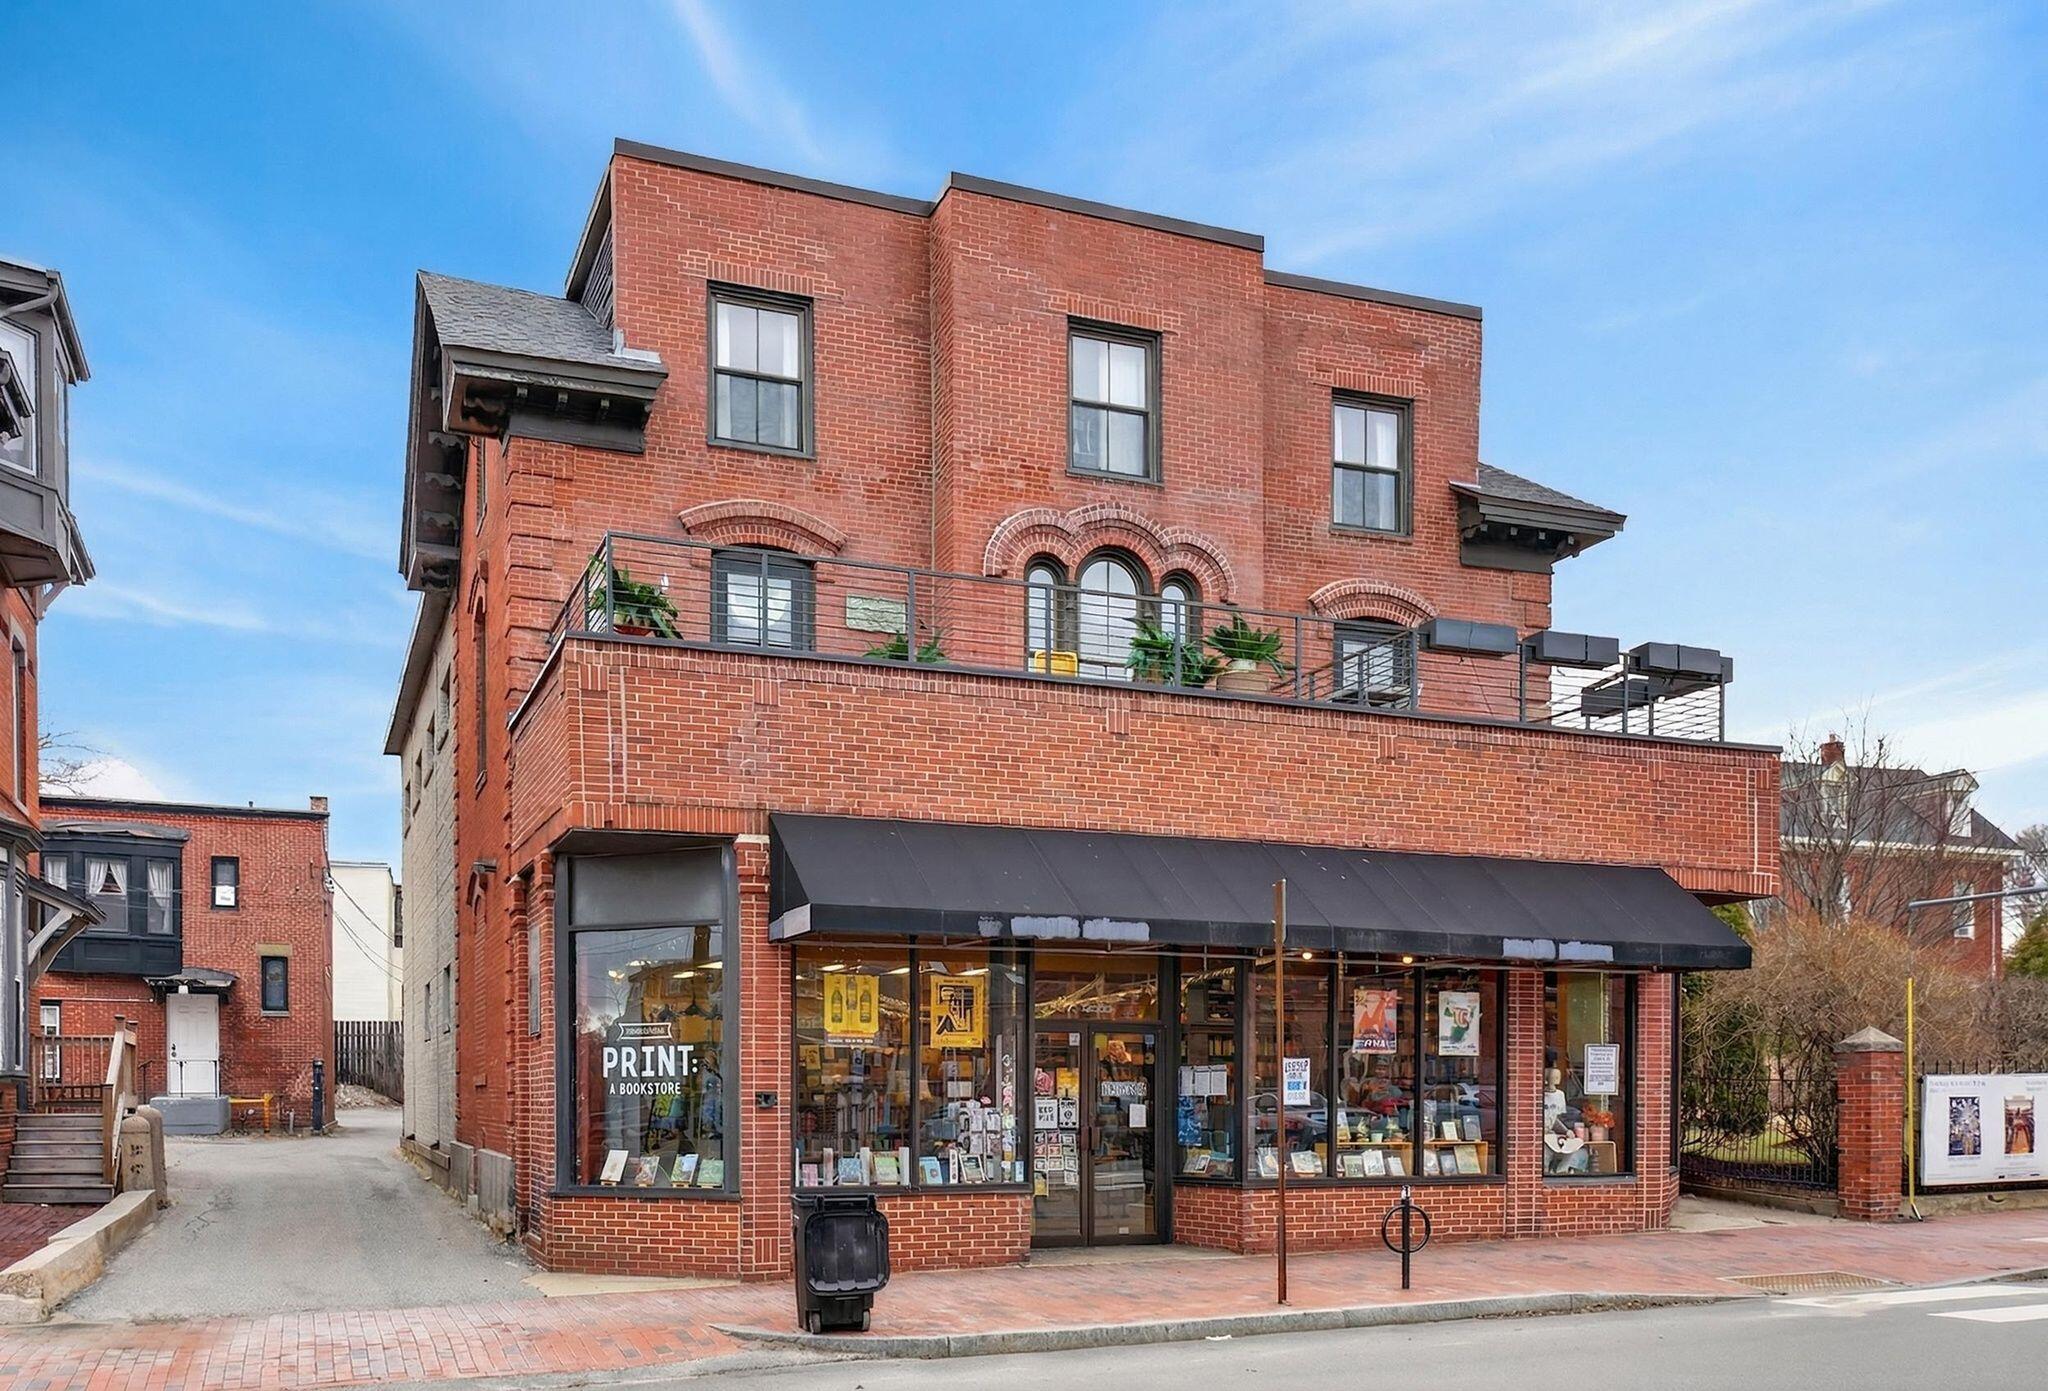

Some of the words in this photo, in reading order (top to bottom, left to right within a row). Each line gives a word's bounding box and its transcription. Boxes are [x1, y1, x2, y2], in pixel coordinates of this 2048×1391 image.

[602, 1045, 698, 1078] PRINT:
[609, 1082, 616, 1095] A
[620, 1082, 682, 1095] BOOKSTORE
